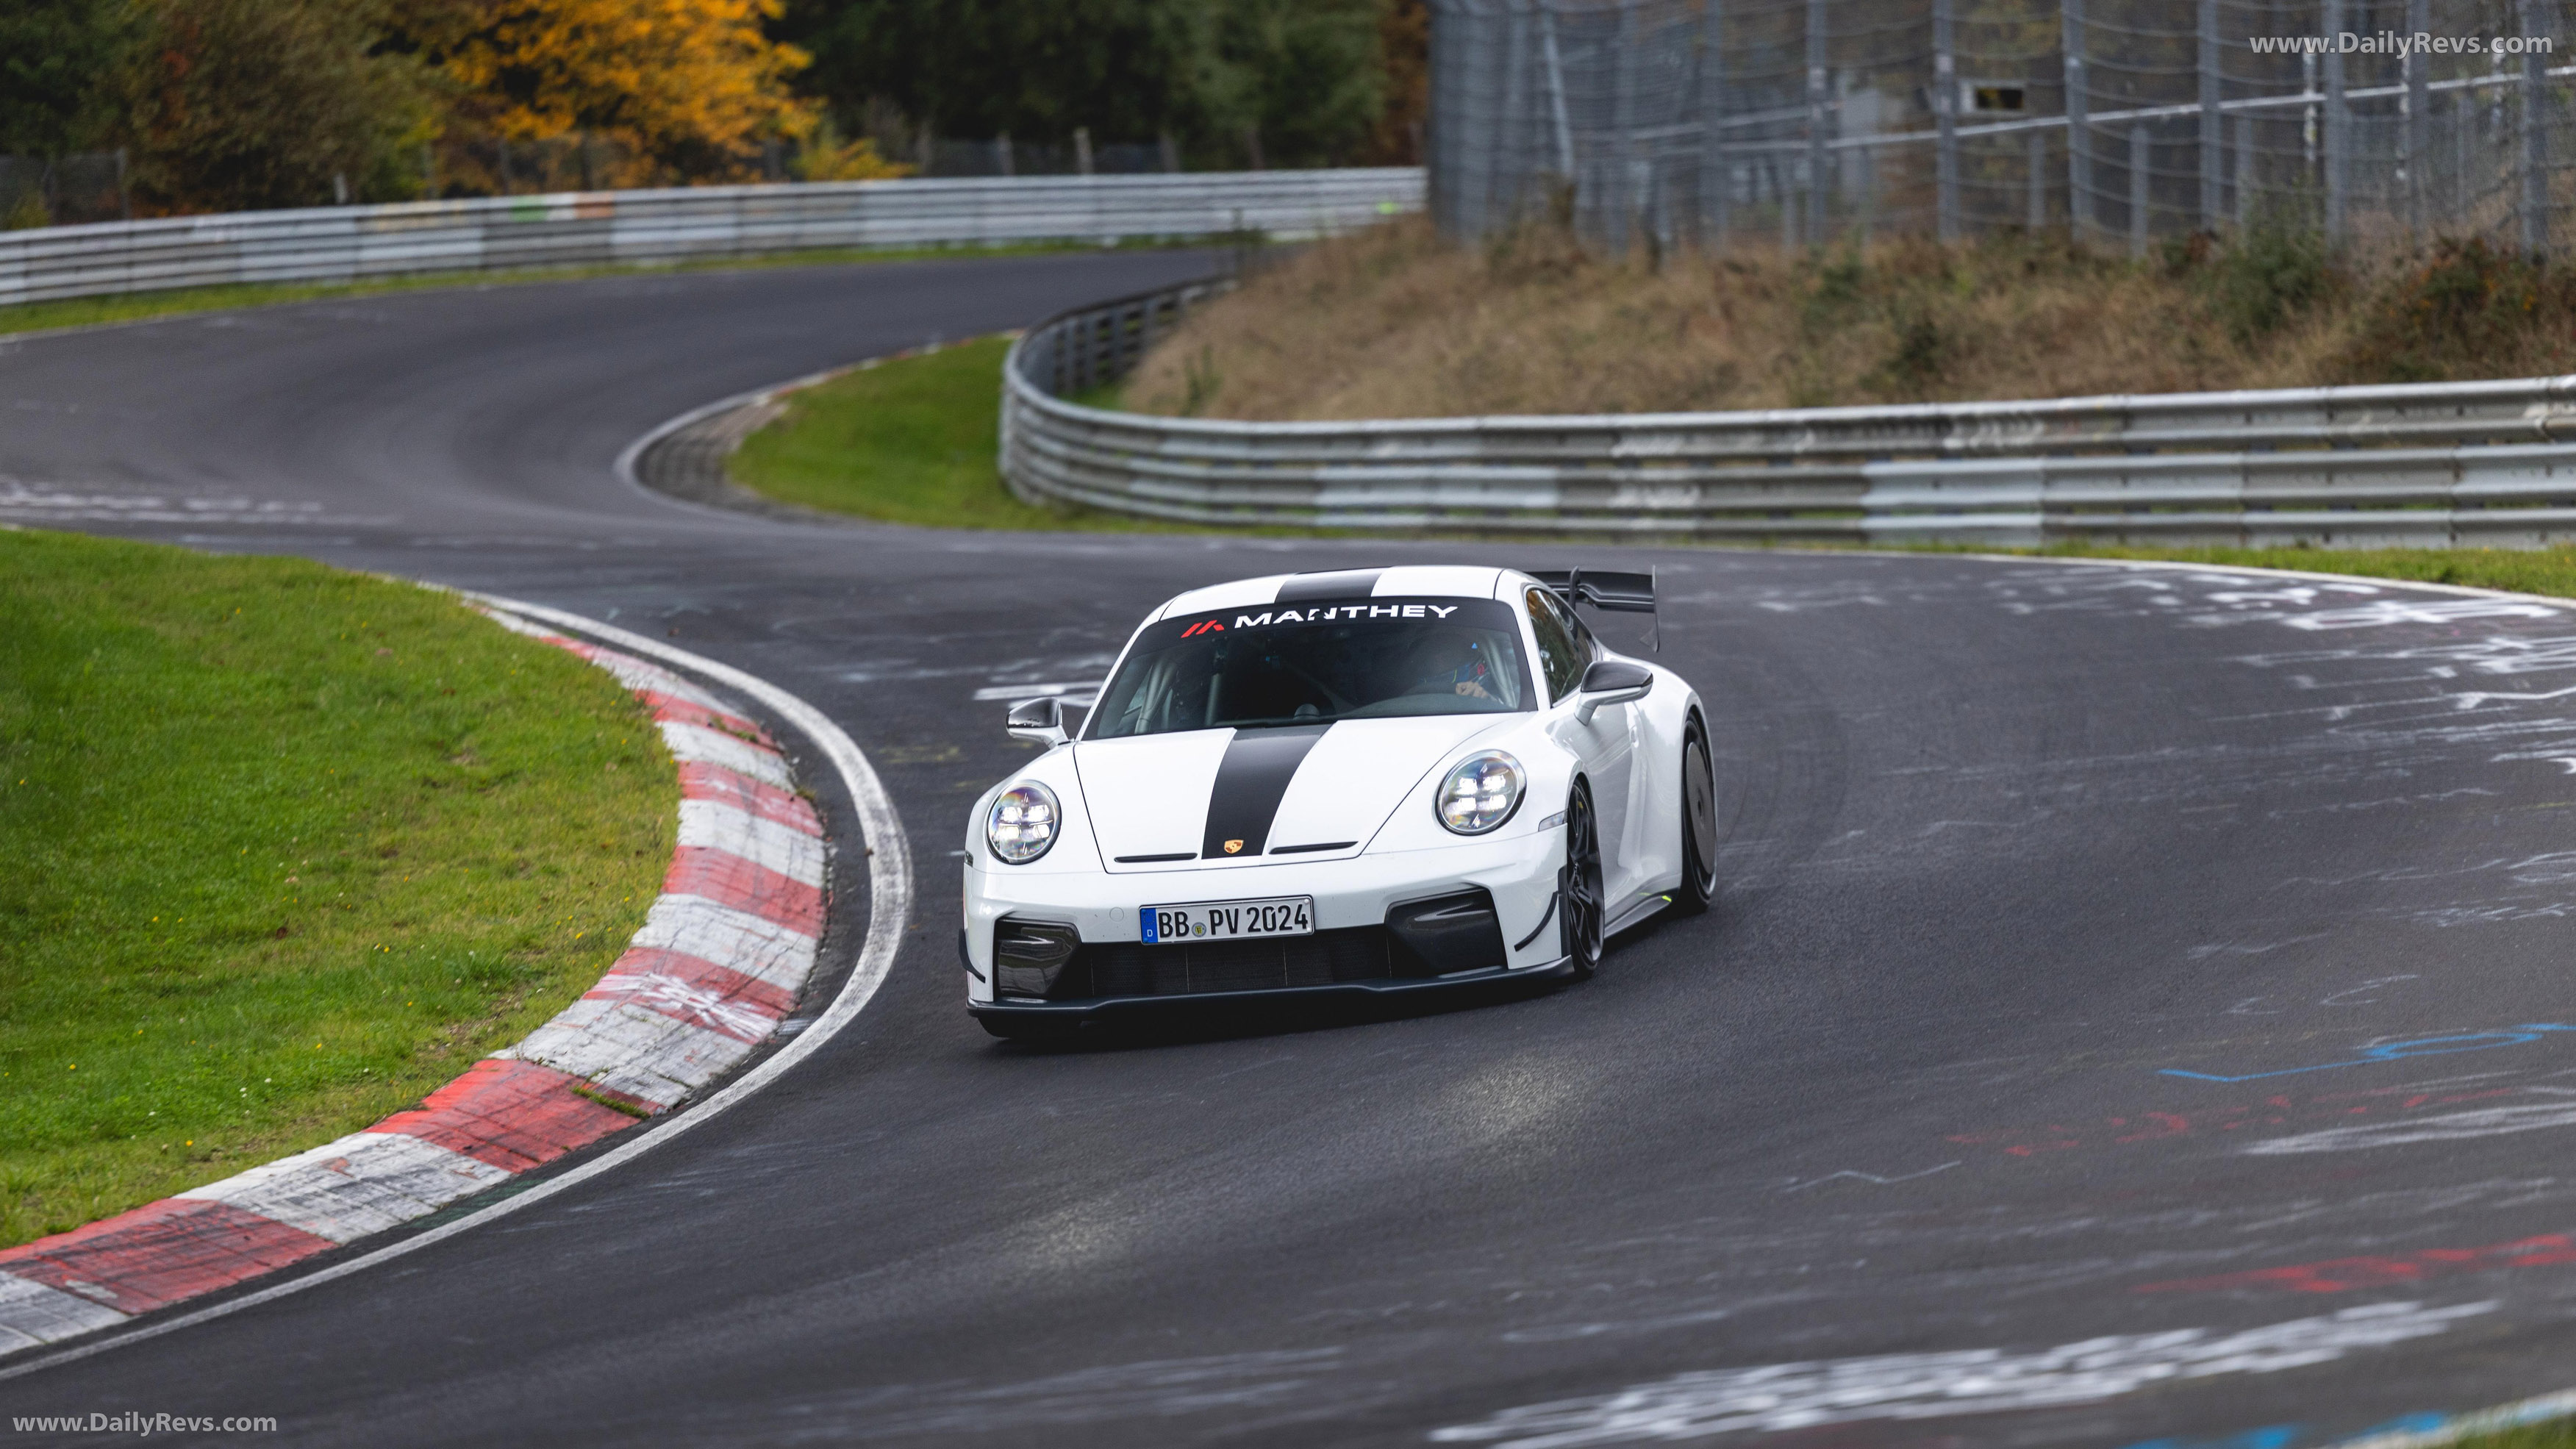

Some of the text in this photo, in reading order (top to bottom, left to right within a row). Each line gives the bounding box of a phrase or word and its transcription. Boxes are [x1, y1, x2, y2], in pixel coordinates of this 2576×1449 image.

[1234, 605, 1458, 628] MANTHEY
[1158, 904, 1309, 938] BB PV 2024
[1147, 929, 1153, 937] D
